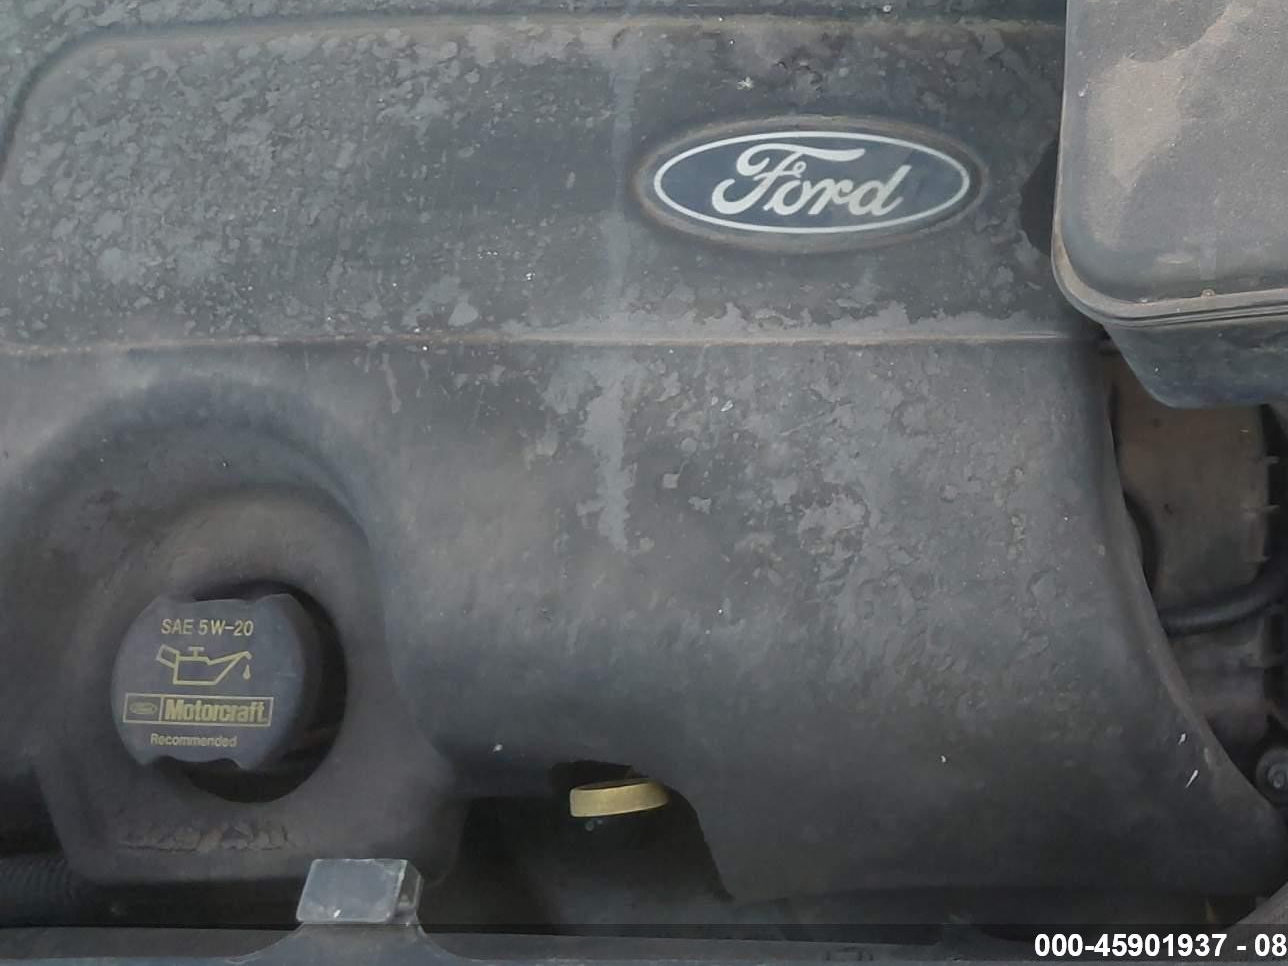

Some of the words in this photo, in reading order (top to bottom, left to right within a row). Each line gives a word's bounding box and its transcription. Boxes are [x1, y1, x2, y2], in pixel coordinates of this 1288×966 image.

[711, 143, 912, 216] Ford
[161, 618, 194, 635] SAE
[198, 619, 255, 636] 5W-20
[165, 698, 265, 723] Motorcraft
[150, 732, 238, 747] Recommended
